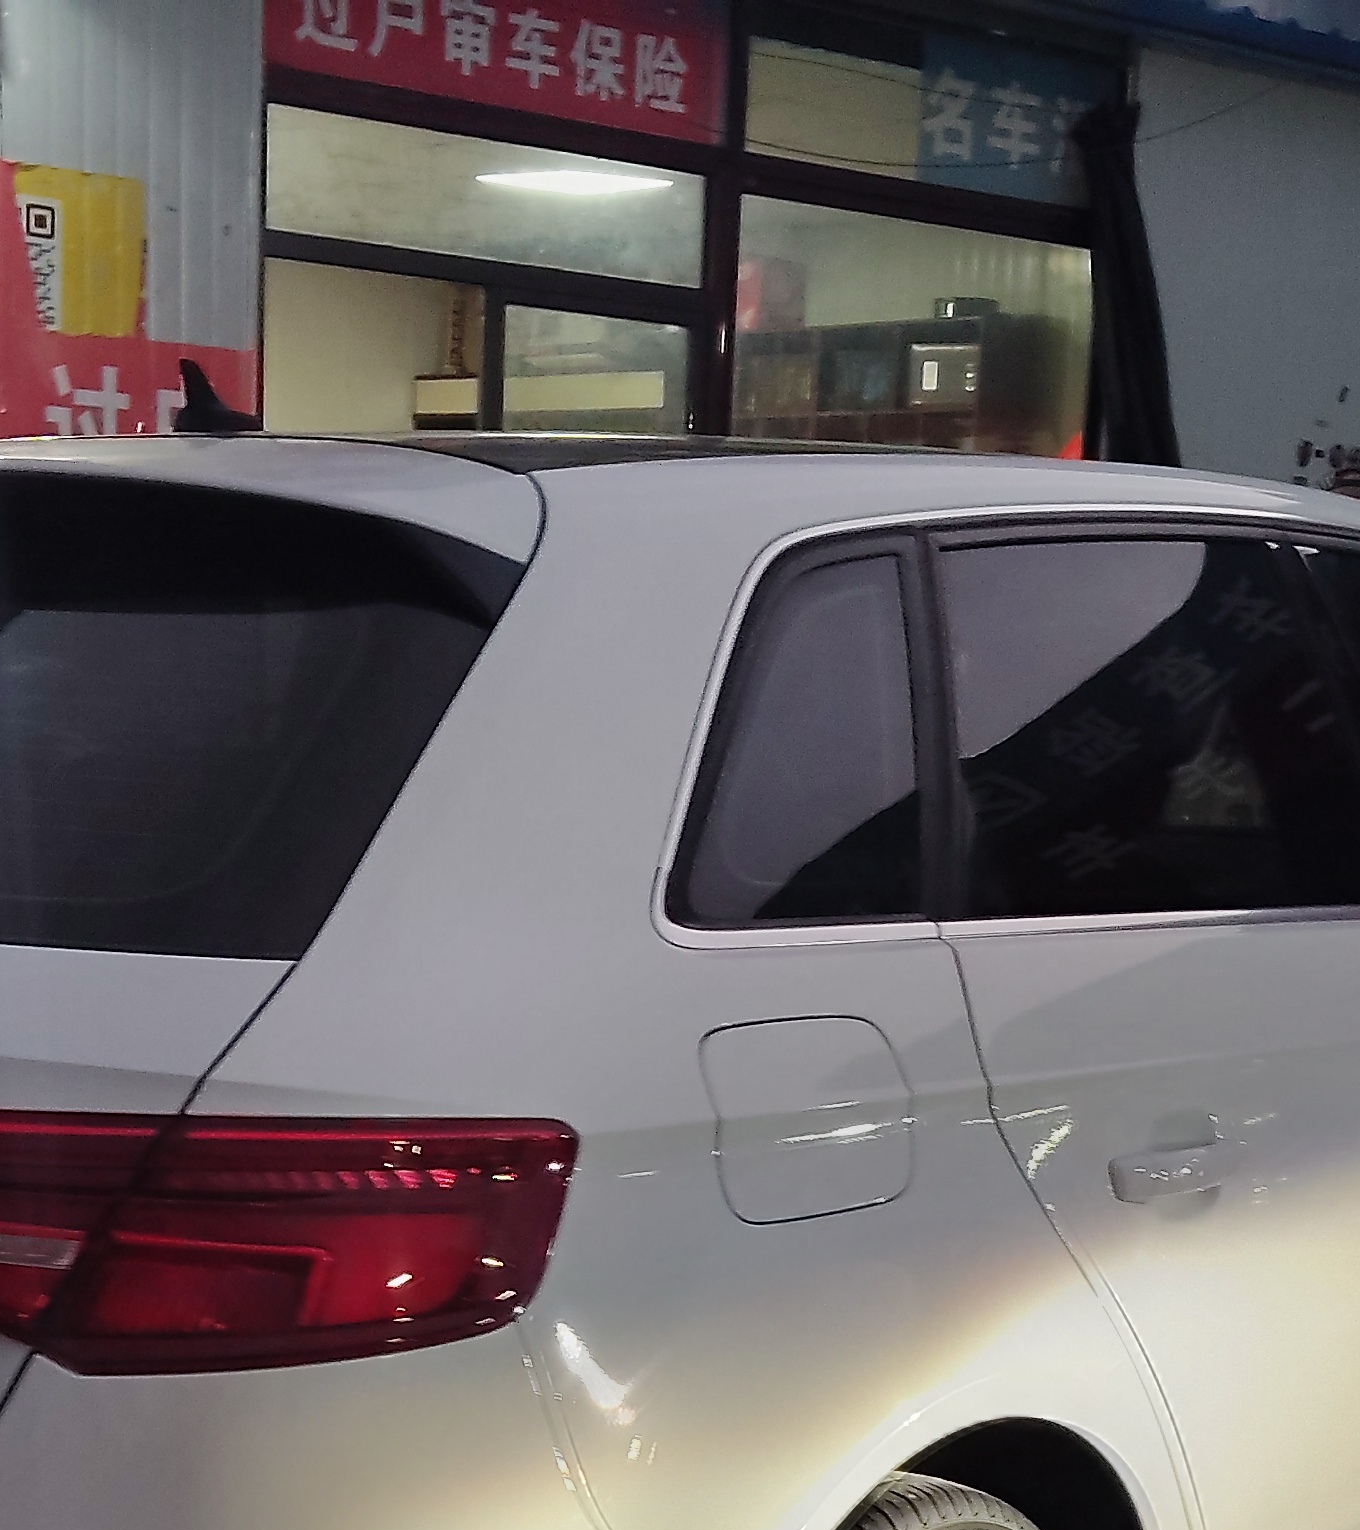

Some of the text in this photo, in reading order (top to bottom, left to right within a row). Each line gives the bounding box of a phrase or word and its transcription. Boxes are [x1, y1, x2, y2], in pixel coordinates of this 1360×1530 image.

[293, 0, 687, 113] 过户审车保险
